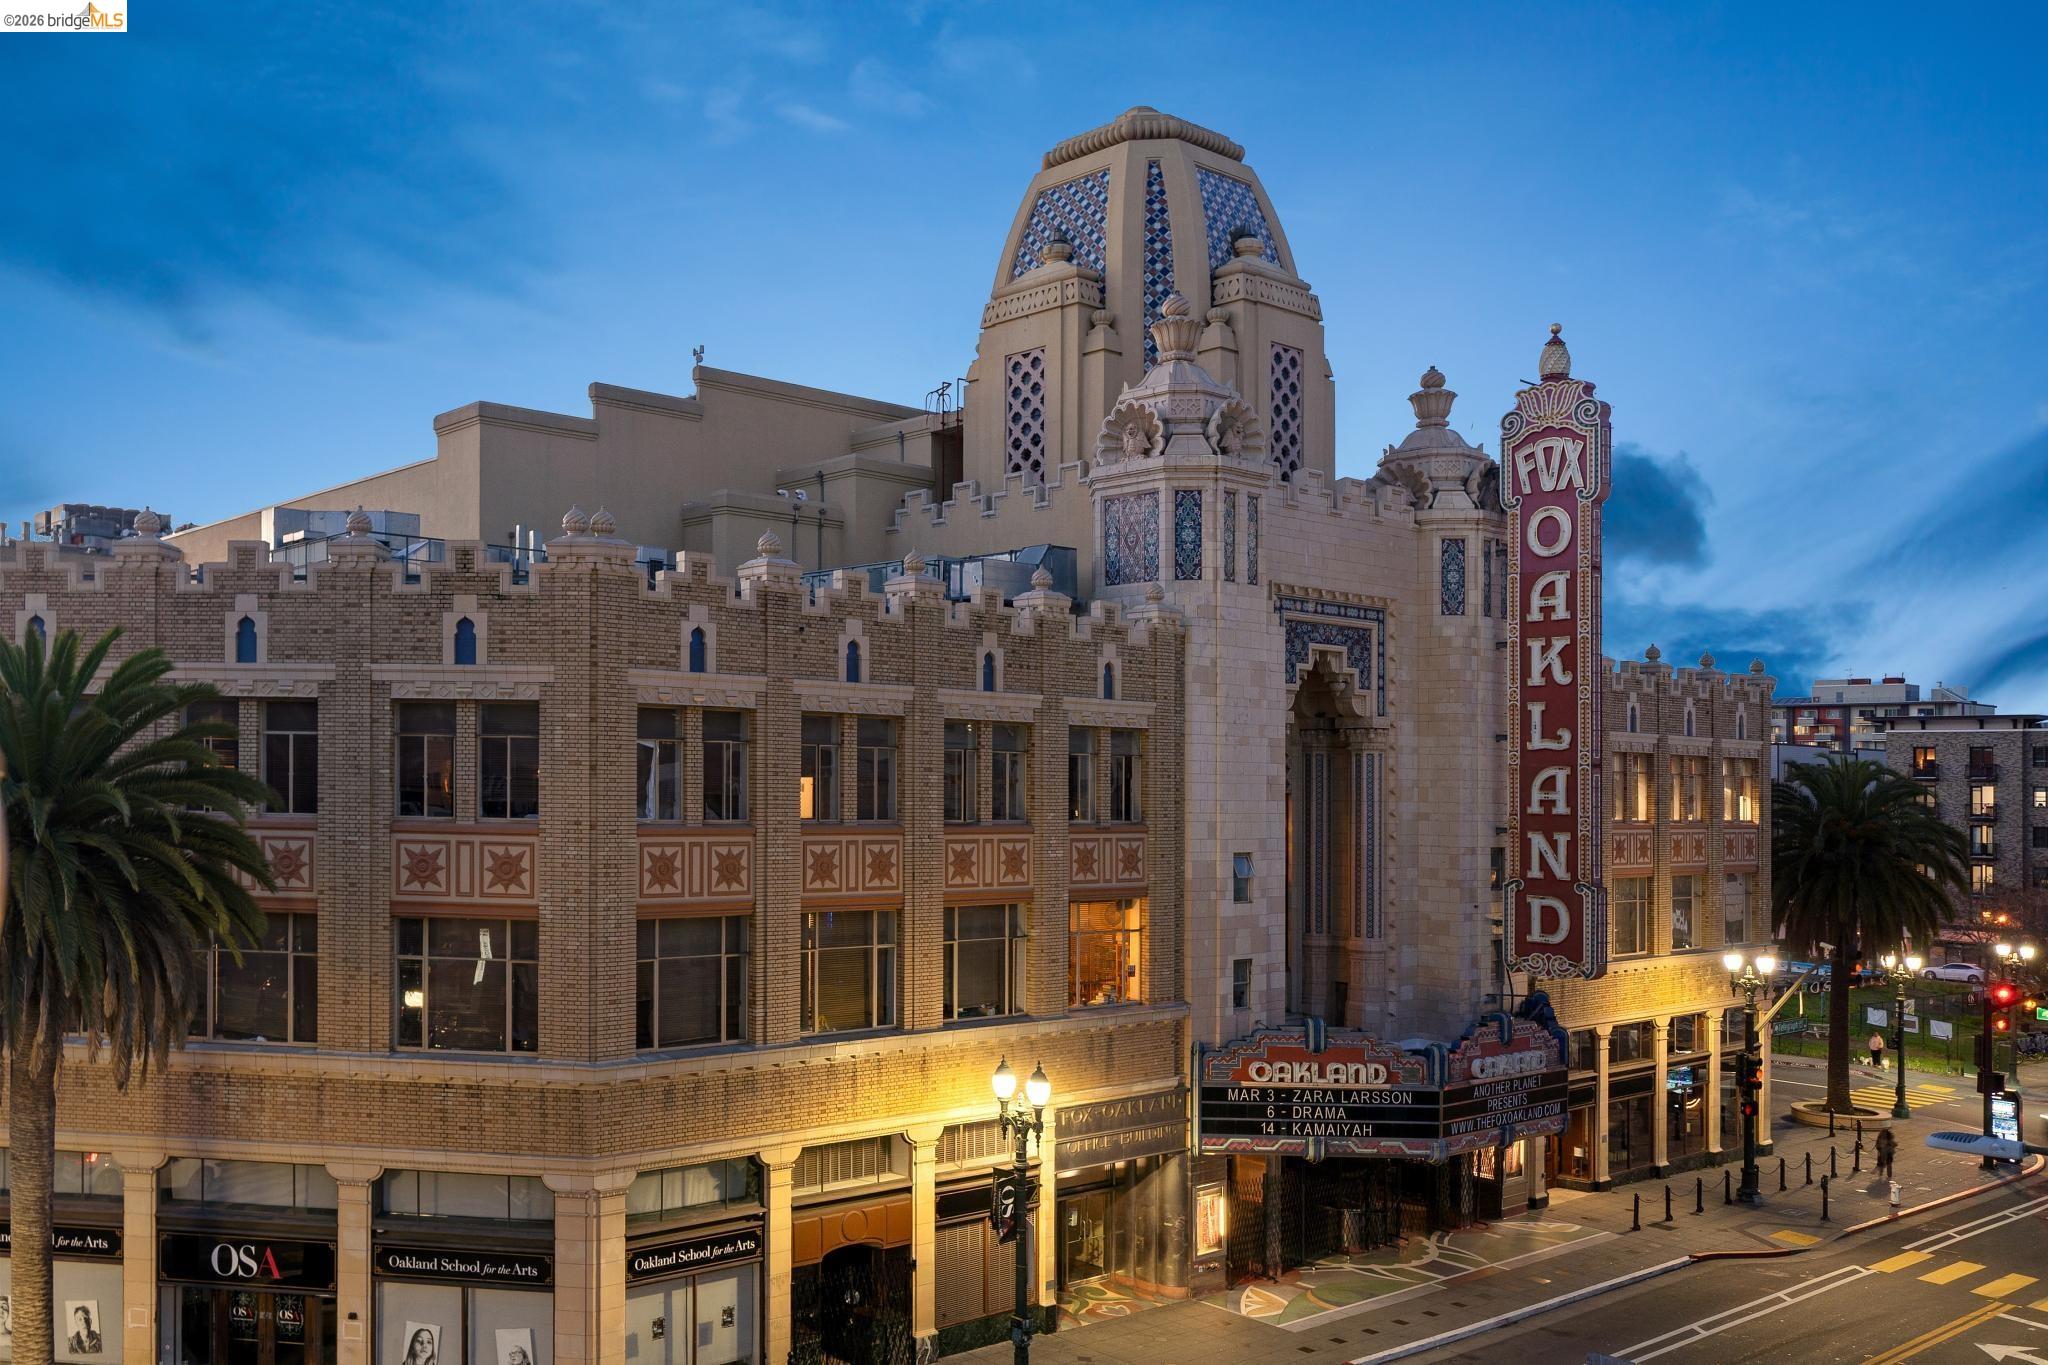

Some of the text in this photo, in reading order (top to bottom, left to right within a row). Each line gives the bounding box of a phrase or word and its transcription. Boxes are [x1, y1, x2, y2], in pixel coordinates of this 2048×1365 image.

[1514, 436, 1585, 496] FOX
[1526, 505, 1573, 945] OAKLAND
[1249, 1061, 1387, 1084] OAKLAND
[1228, 1089, 1260, 1101] MAR
[1267, 1089, 1275, 1102] 3
[1293, 1090, 1334, 1103] ZARA
[1341, 1091, 1412, 1104] LARSSON
[1473, 1075, 1543, 1099] ANOTHER PLANET
[1267, 1106, 1275, 1118] 6
[1293, 1106, 1346, 1119] DRAMA
[1488, 1093, 1528, 1112] PRESENTS
[1261, 1122, 1275, 1135] 14
[1293, 1123, 1372, 1136] KAMAIYAH
[1451, 1103, 1561, 1135] WWW.THEFOXOAKLAND.COM
[1067, 1135, 1112, 1153] OFFICE
[55, 1236, 70, 1248] for
[71, 1237, 83, 1247] the
[84, 1235, 108, 1249] Arts
[211, 1243, 283, 1279] OSA
[635, 1239, 756, 1271] Oakland School for the Arts
[389, 1255, 538, 1276] Oakland School for the Arts
[233, 1307, 253, 1317] OSA
[280, 1310, 300, 1321] OSA
